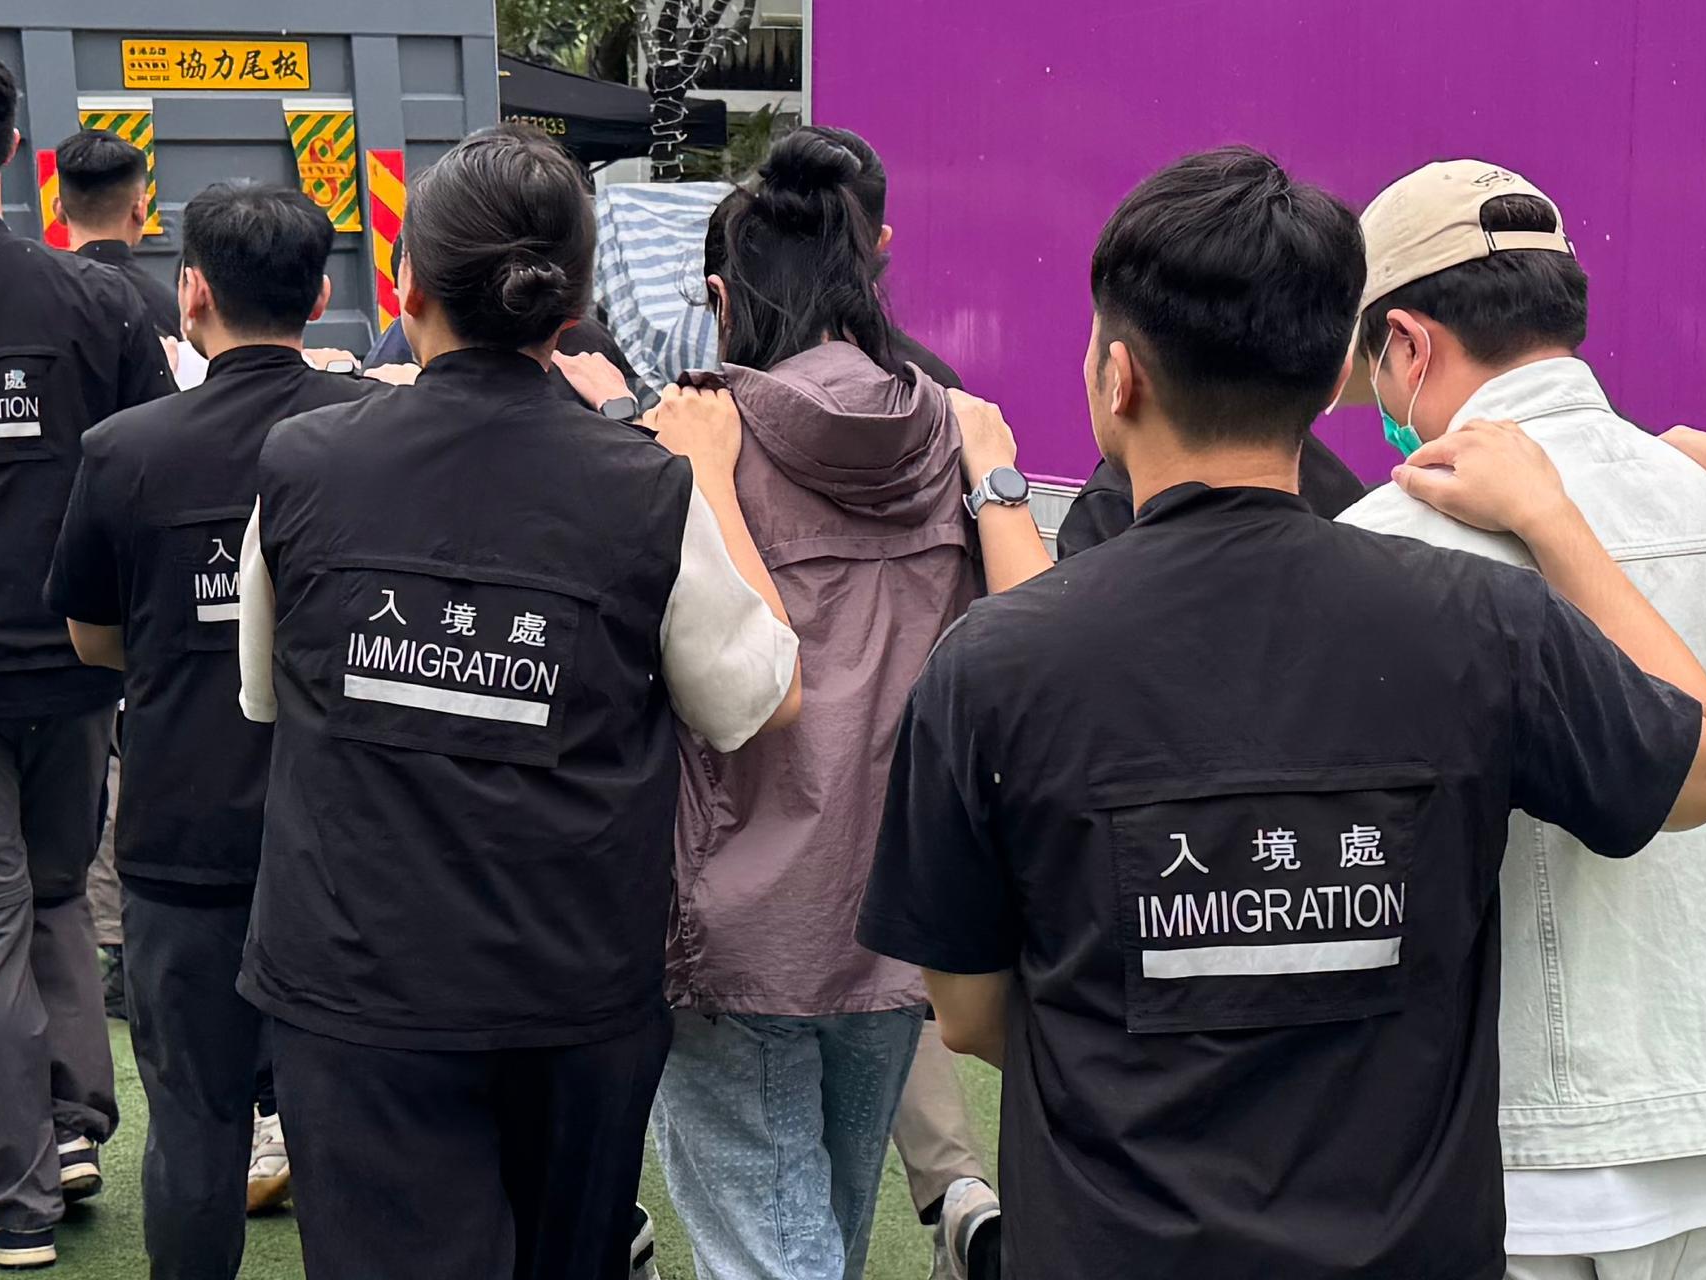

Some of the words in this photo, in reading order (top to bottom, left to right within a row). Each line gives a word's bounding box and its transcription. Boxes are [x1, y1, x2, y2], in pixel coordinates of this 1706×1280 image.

[175, 47, 304, 81] 協力尾板
[368, 588, 548, 648] 入境處
[346, 631, 561, 697] IMMIGRATION
[1160, 823, 1386, 878] 入境處
[1137, 881, 1406, 939] IMMIGRATION
